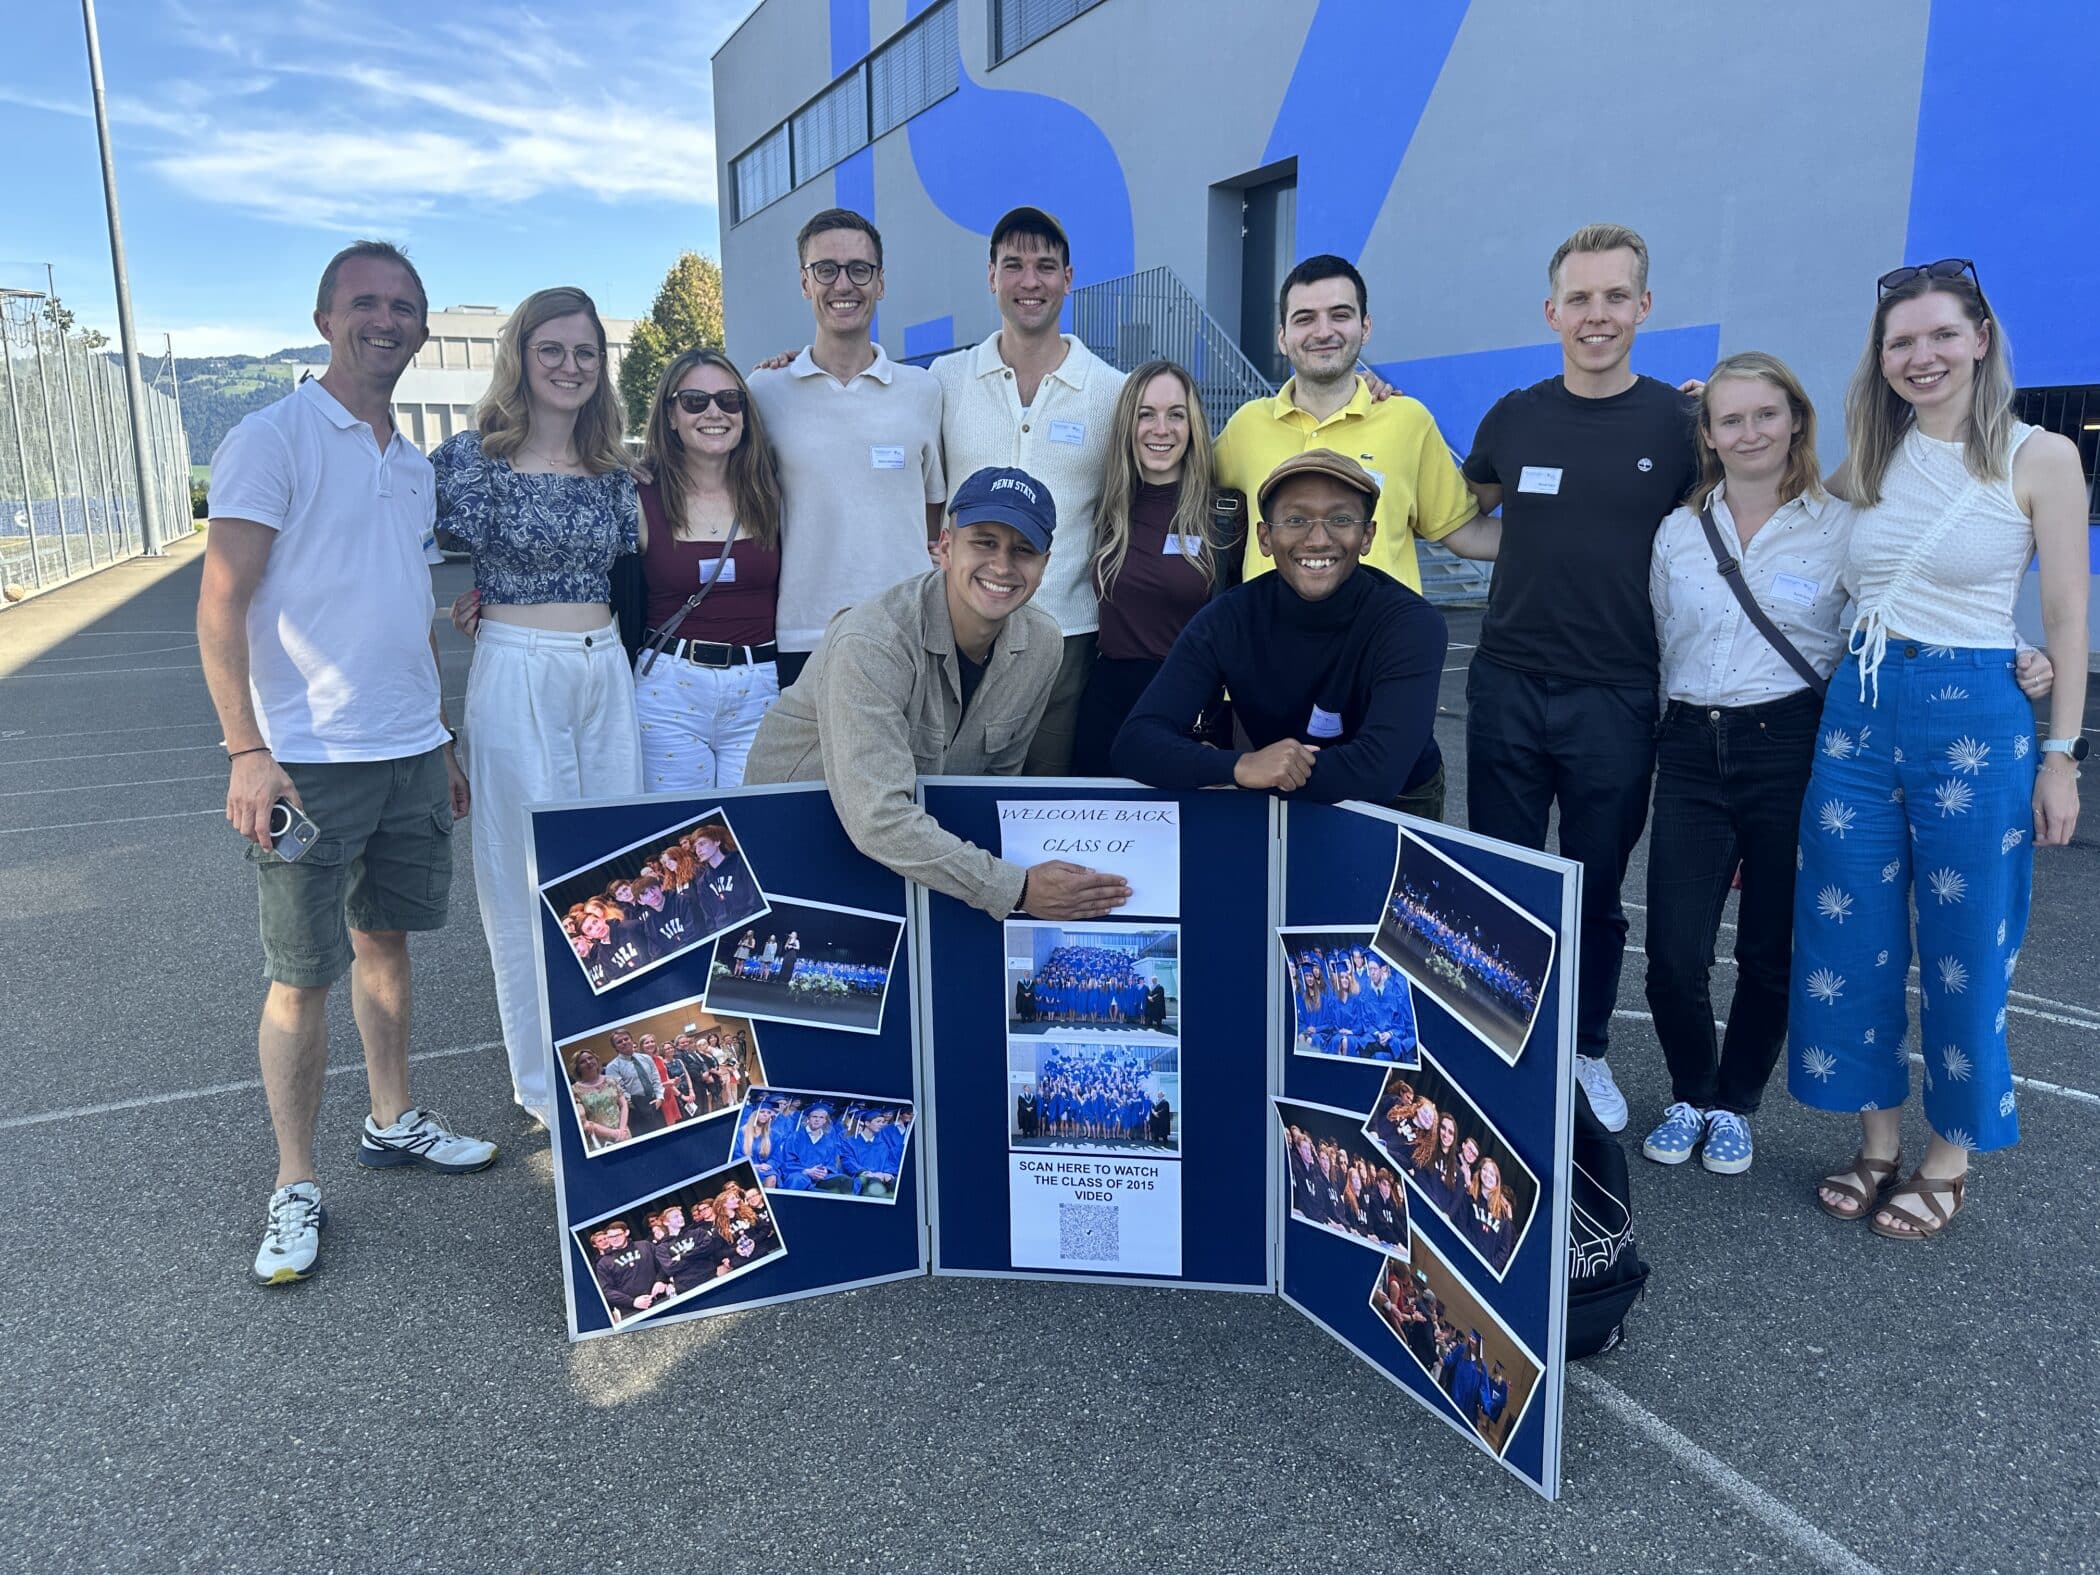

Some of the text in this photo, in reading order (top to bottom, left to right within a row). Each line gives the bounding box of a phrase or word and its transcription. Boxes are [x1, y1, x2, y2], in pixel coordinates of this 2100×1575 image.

[990, 478, 1037, 504] PENN STATE
[1002, 808, 1176, 825] WELCOME BACK
[1043, 838, 1135, 852] CLASS OF
[1019, 1161, 1158, 1177] SCAN HERE TO WATCH
[1034, 1175, 1154, 1190] THE CLASS OF 2015
[1074, 1191, 1113, 1202] VIDEO
